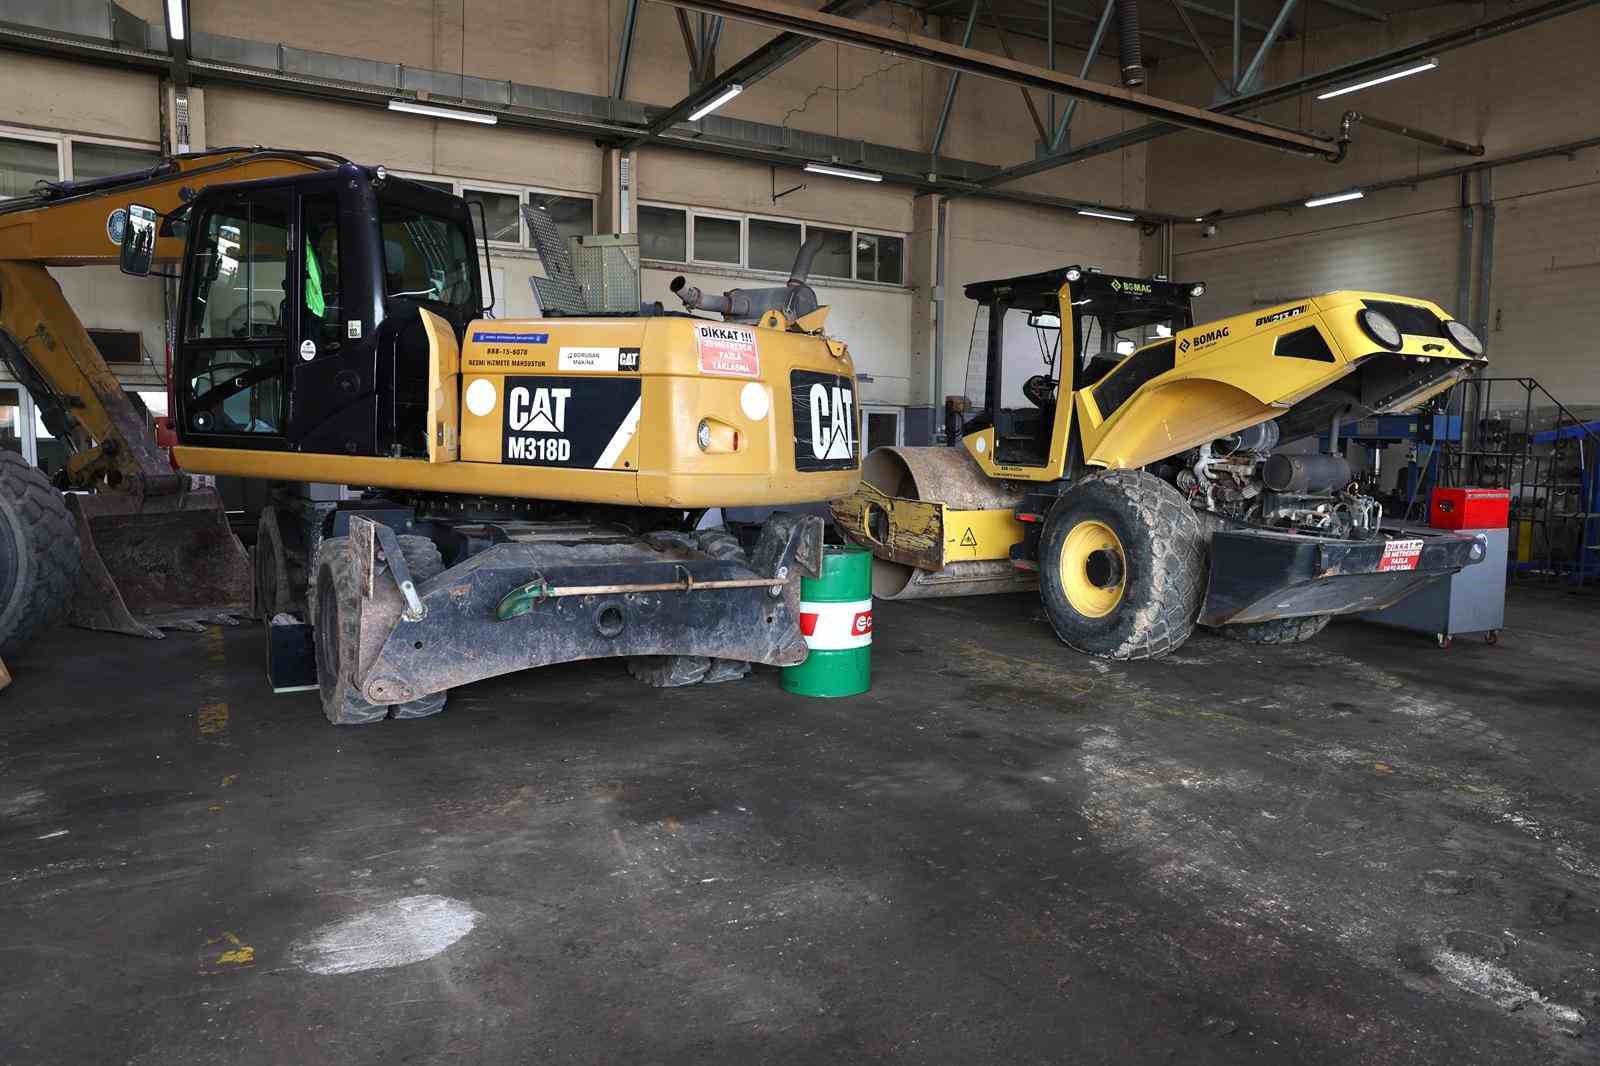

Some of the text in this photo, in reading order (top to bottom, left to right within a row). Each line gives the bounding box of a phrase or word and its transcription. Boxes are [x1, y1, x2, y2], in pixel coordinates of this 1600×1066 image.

[1193, 327, 1230, 347] BOMAG
[620, 352, 638, 366] CAT
[509, 386, 572, 432] CAT
[810, 383, 853, 460] CAT
[508, 437, 571, 461] M318D
